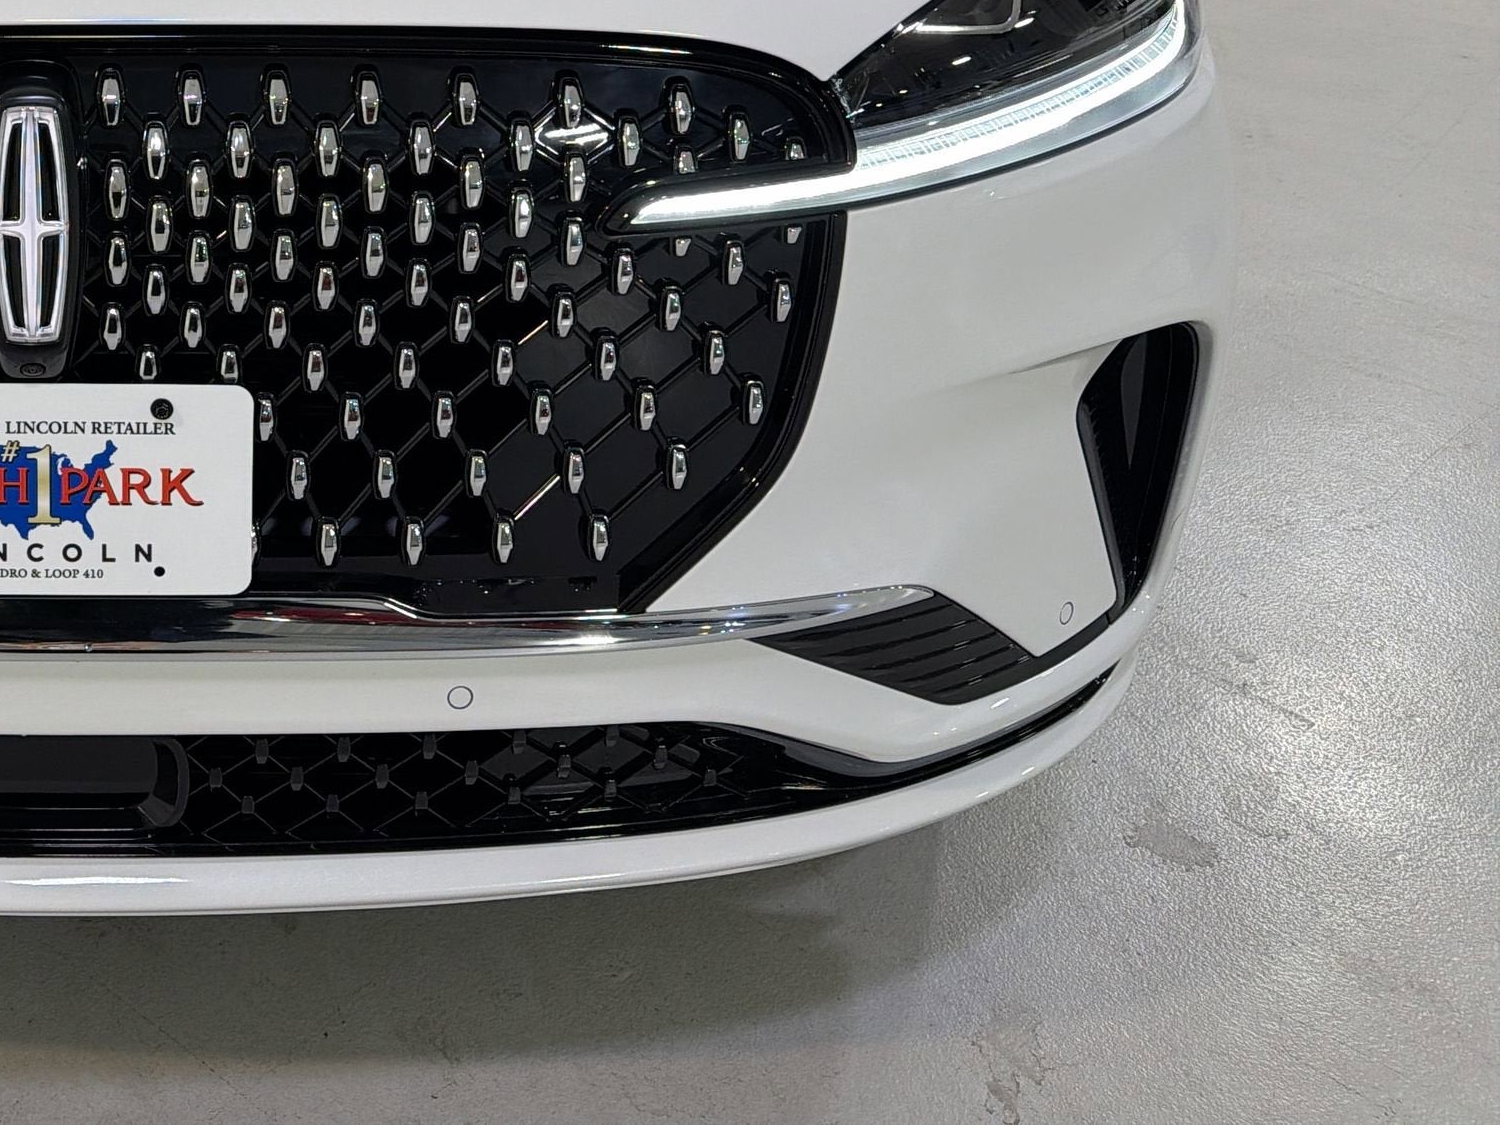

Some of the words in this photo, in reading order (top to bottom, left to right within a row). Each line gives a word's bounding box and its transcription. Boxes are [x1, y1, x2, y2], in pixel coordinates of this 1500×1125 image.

[5, 421, 86, 435] LINCOLN
[91, 421, 176, 435] RETAILER
[60, 467, 204, 507] PARK
[30, 568, 42, 579] &
[44, 568, 80, 579] LOOP
[83, 568, 104, 579] 410
